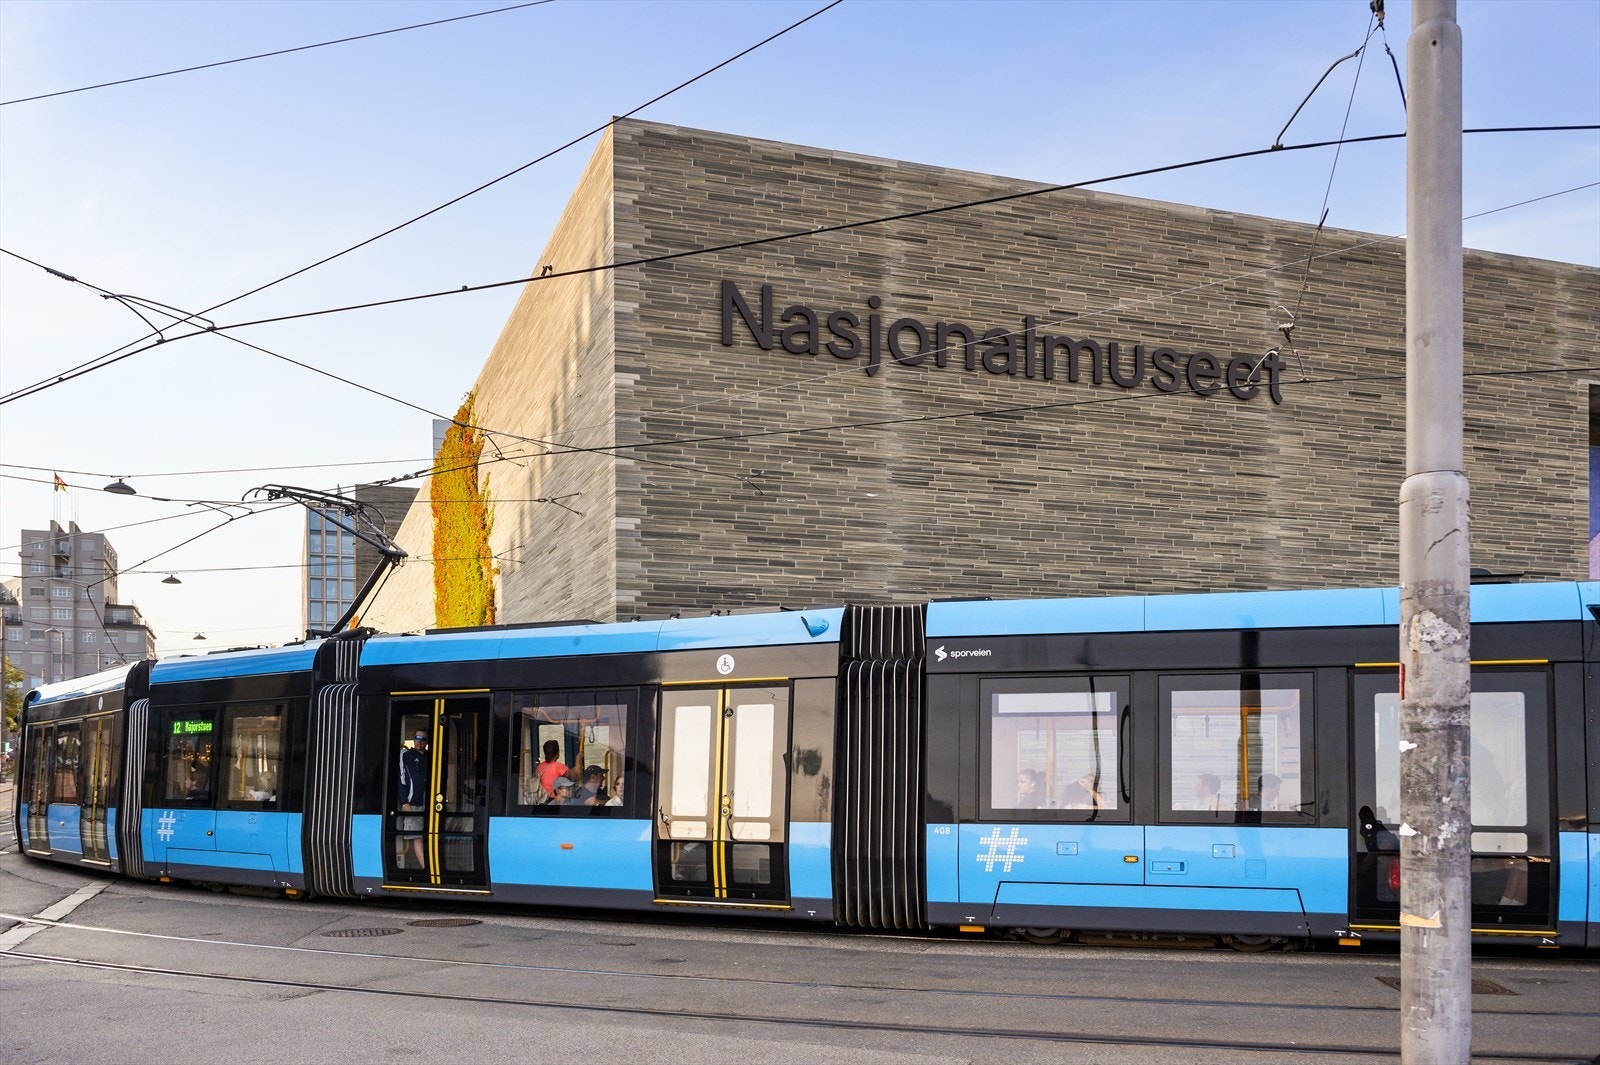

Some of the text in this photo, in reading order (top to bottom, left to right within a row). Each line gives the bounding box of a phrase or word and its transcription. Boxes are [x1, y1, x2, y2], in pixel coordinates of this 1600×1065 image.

[720, 279, 1286, 405] Nasjonalmuseet
[950, 648, 992, 659] sporveien
[173, 721, 181, 734] 12
[934, 826, 951, 835] 408
